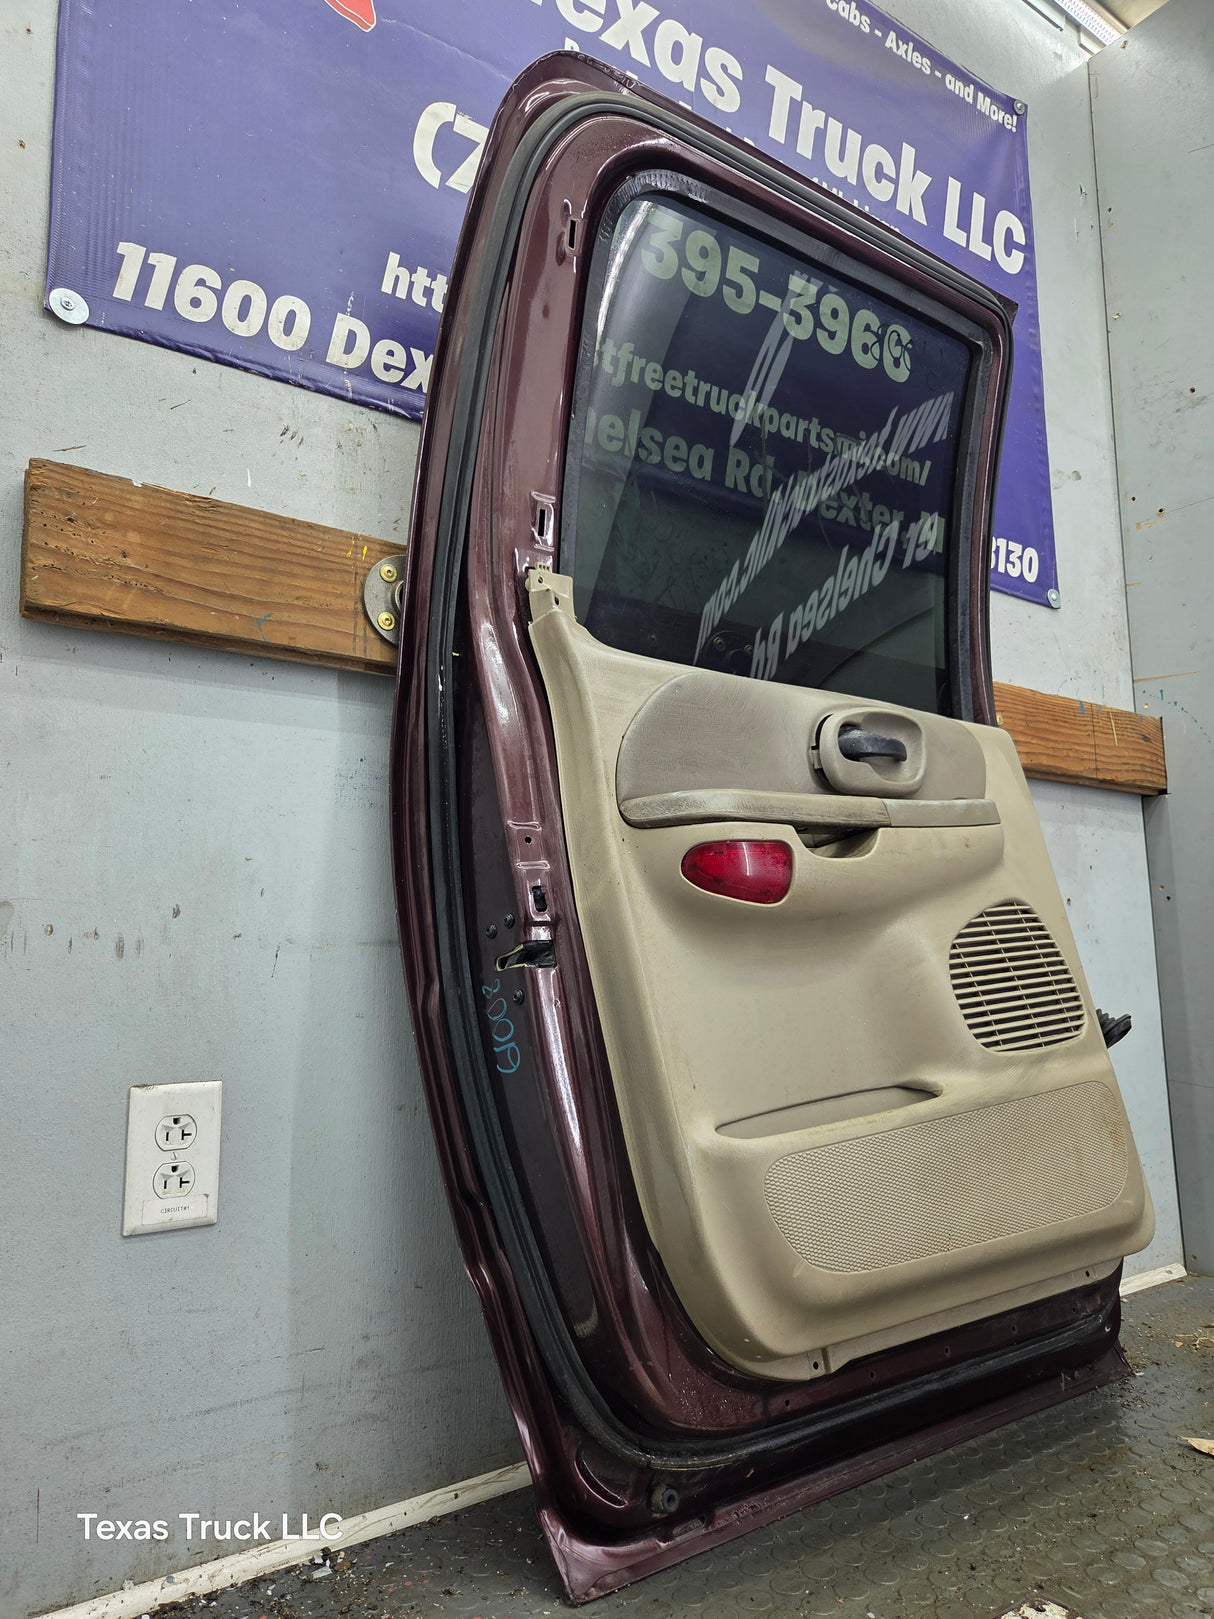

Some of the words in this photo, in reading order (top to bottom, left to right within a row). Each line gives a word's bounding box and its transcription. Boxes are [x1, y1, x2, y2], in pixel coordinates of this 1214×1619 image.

[884, 30, 932, 75] Axles
[945, 73, 975, 104] and
[976, 91, 1018, 132] More!
[530, 0, 744, 113] exas
[765, 64, 933, 226] Truck
[942, 176, 1027, 275] LLC
[112, 241, 312, 351] 11600
